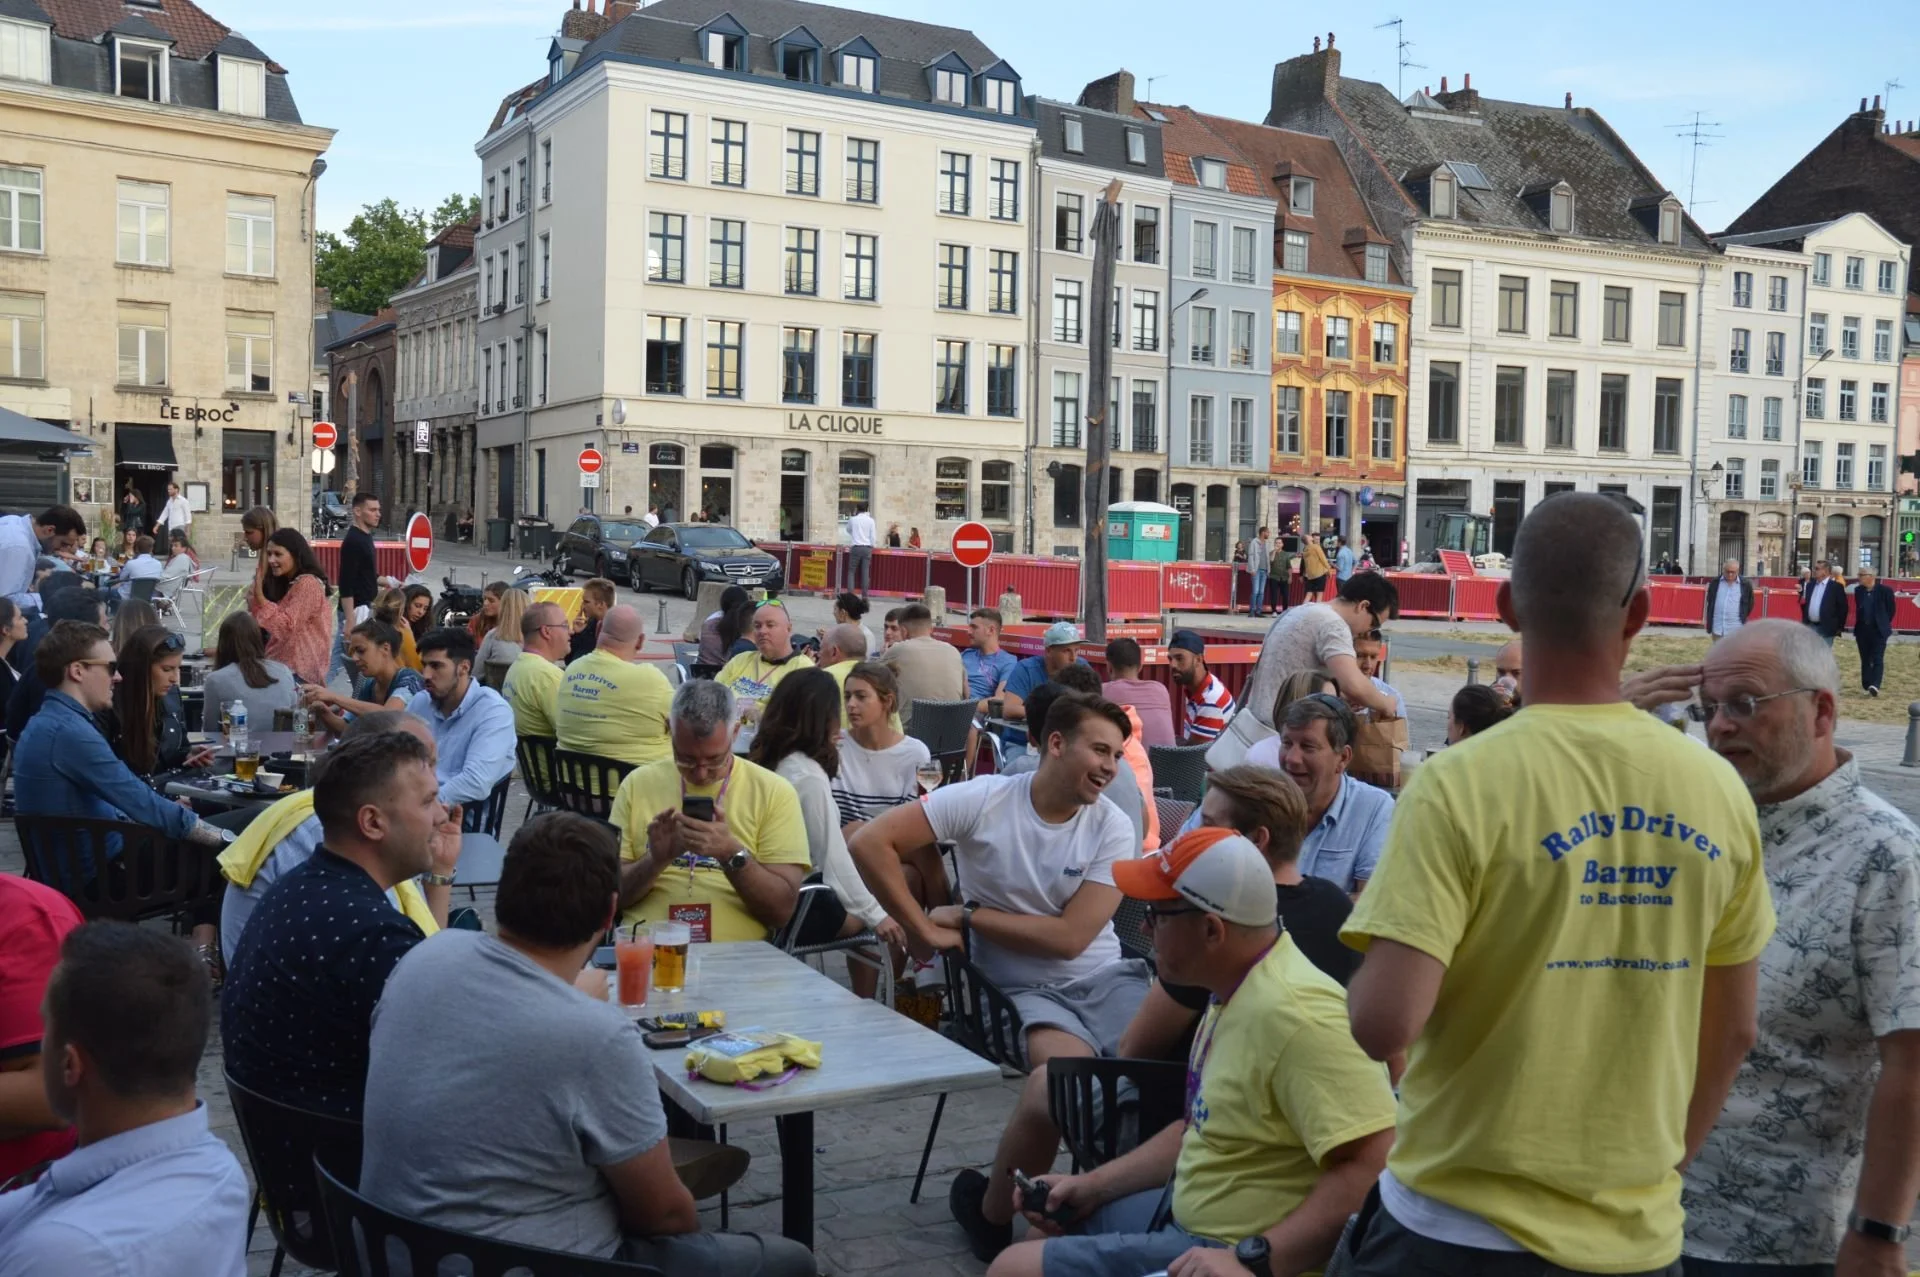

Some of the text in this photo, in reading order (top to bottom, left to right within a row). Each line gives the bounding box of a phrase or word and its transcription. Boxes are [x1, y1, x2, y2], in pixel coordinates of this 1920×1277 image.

[160, 405, 235, 423] LE BROC
[788, 413, 883, 435] LA CLIQUE
[588, 673, 618, 690] Driver
[1541, 806, 1722, 862] Rally Driver
[1582, 860, 1677, 889] Barmy
[1580, 893, 1594, 905] to
